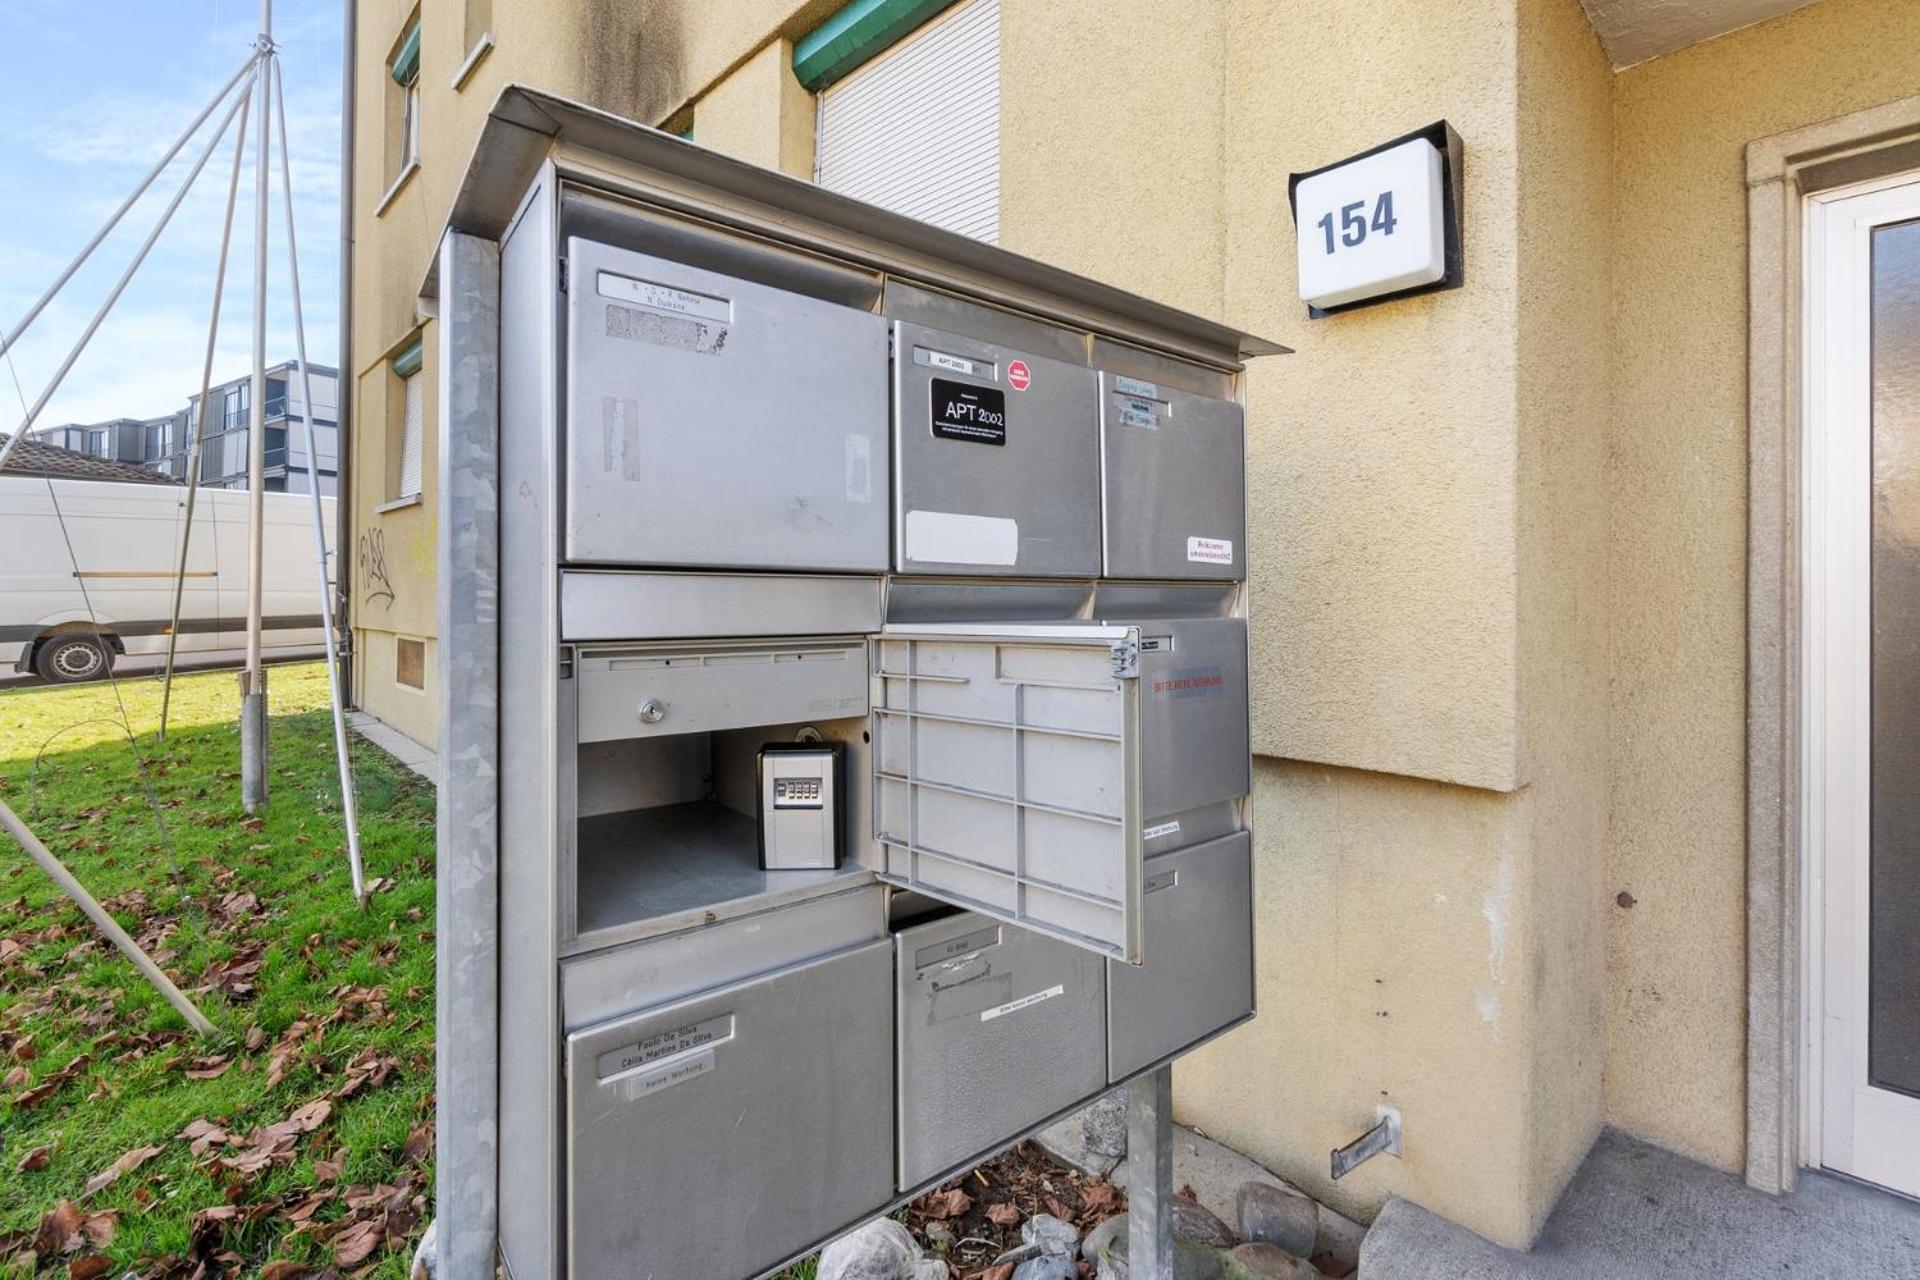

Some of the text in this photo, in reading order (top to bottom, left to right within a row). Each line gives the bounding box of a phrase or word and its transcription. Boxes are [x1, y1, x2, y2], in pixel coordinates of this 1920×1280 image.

[1318, 191, 1397, 255] 154
[945, 401, 1004, 426] APT 2002
[638, 1036, 661, 1051] Paulo
[678, 1025, 697, 1038] Silva
[693, 1032, 712, 1045] Silva
